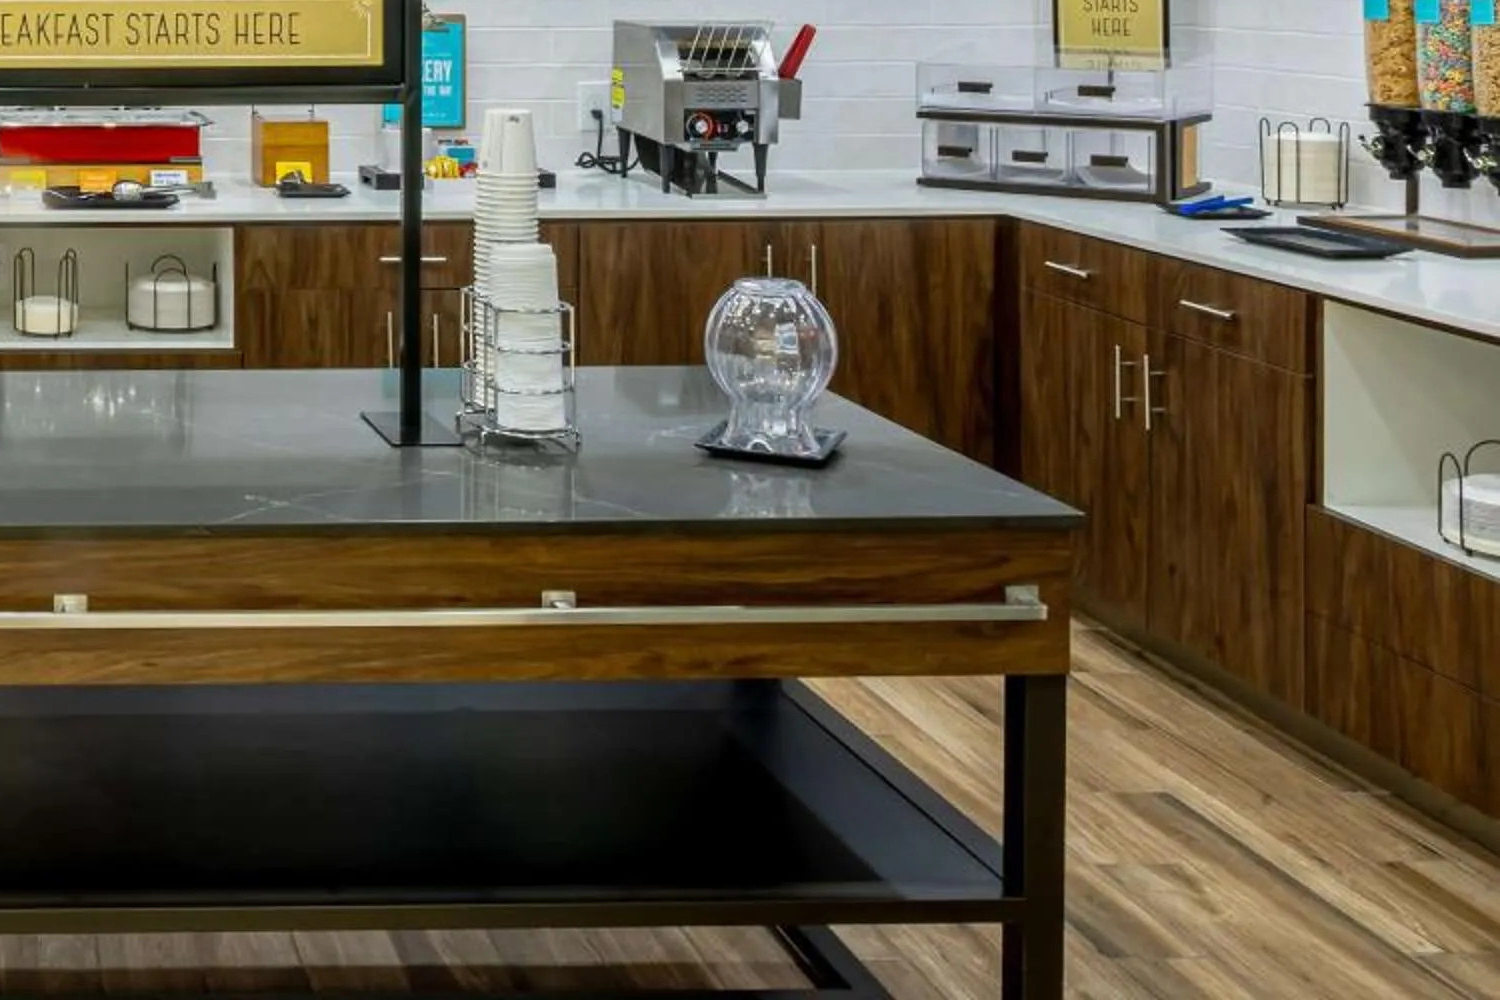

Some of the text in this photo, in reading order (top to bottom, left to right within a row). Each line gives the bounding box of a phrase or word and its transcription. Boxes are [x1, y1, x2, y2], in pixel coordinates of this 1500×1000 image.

[125, 12, 221, 46] STARTS
[234, 12, 301, 46] HERE
[1091, 17, 1131, 37] HERE
